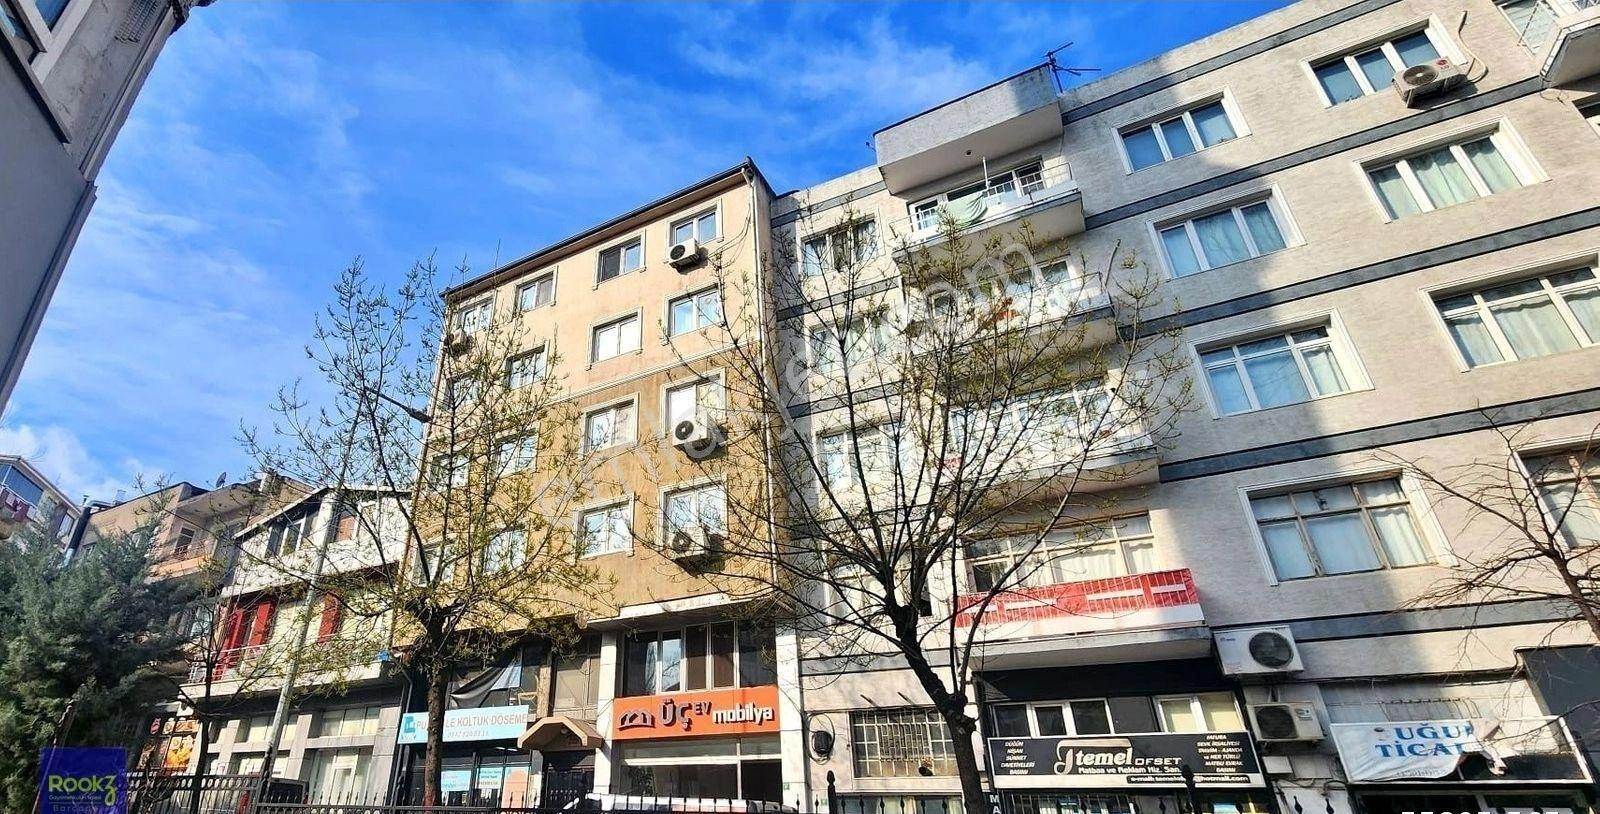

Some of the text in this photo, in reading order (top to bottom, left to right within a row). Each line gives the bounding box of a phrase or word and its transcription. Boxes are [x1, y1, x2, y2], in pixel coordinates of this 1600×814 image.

[713, 702, 774, 725] mobilya
[457, 714, 489, 727] KOLTUK
[1134, 757, 1182, 766] OFSET
[1118, 766, 1147, 774] Reklam
